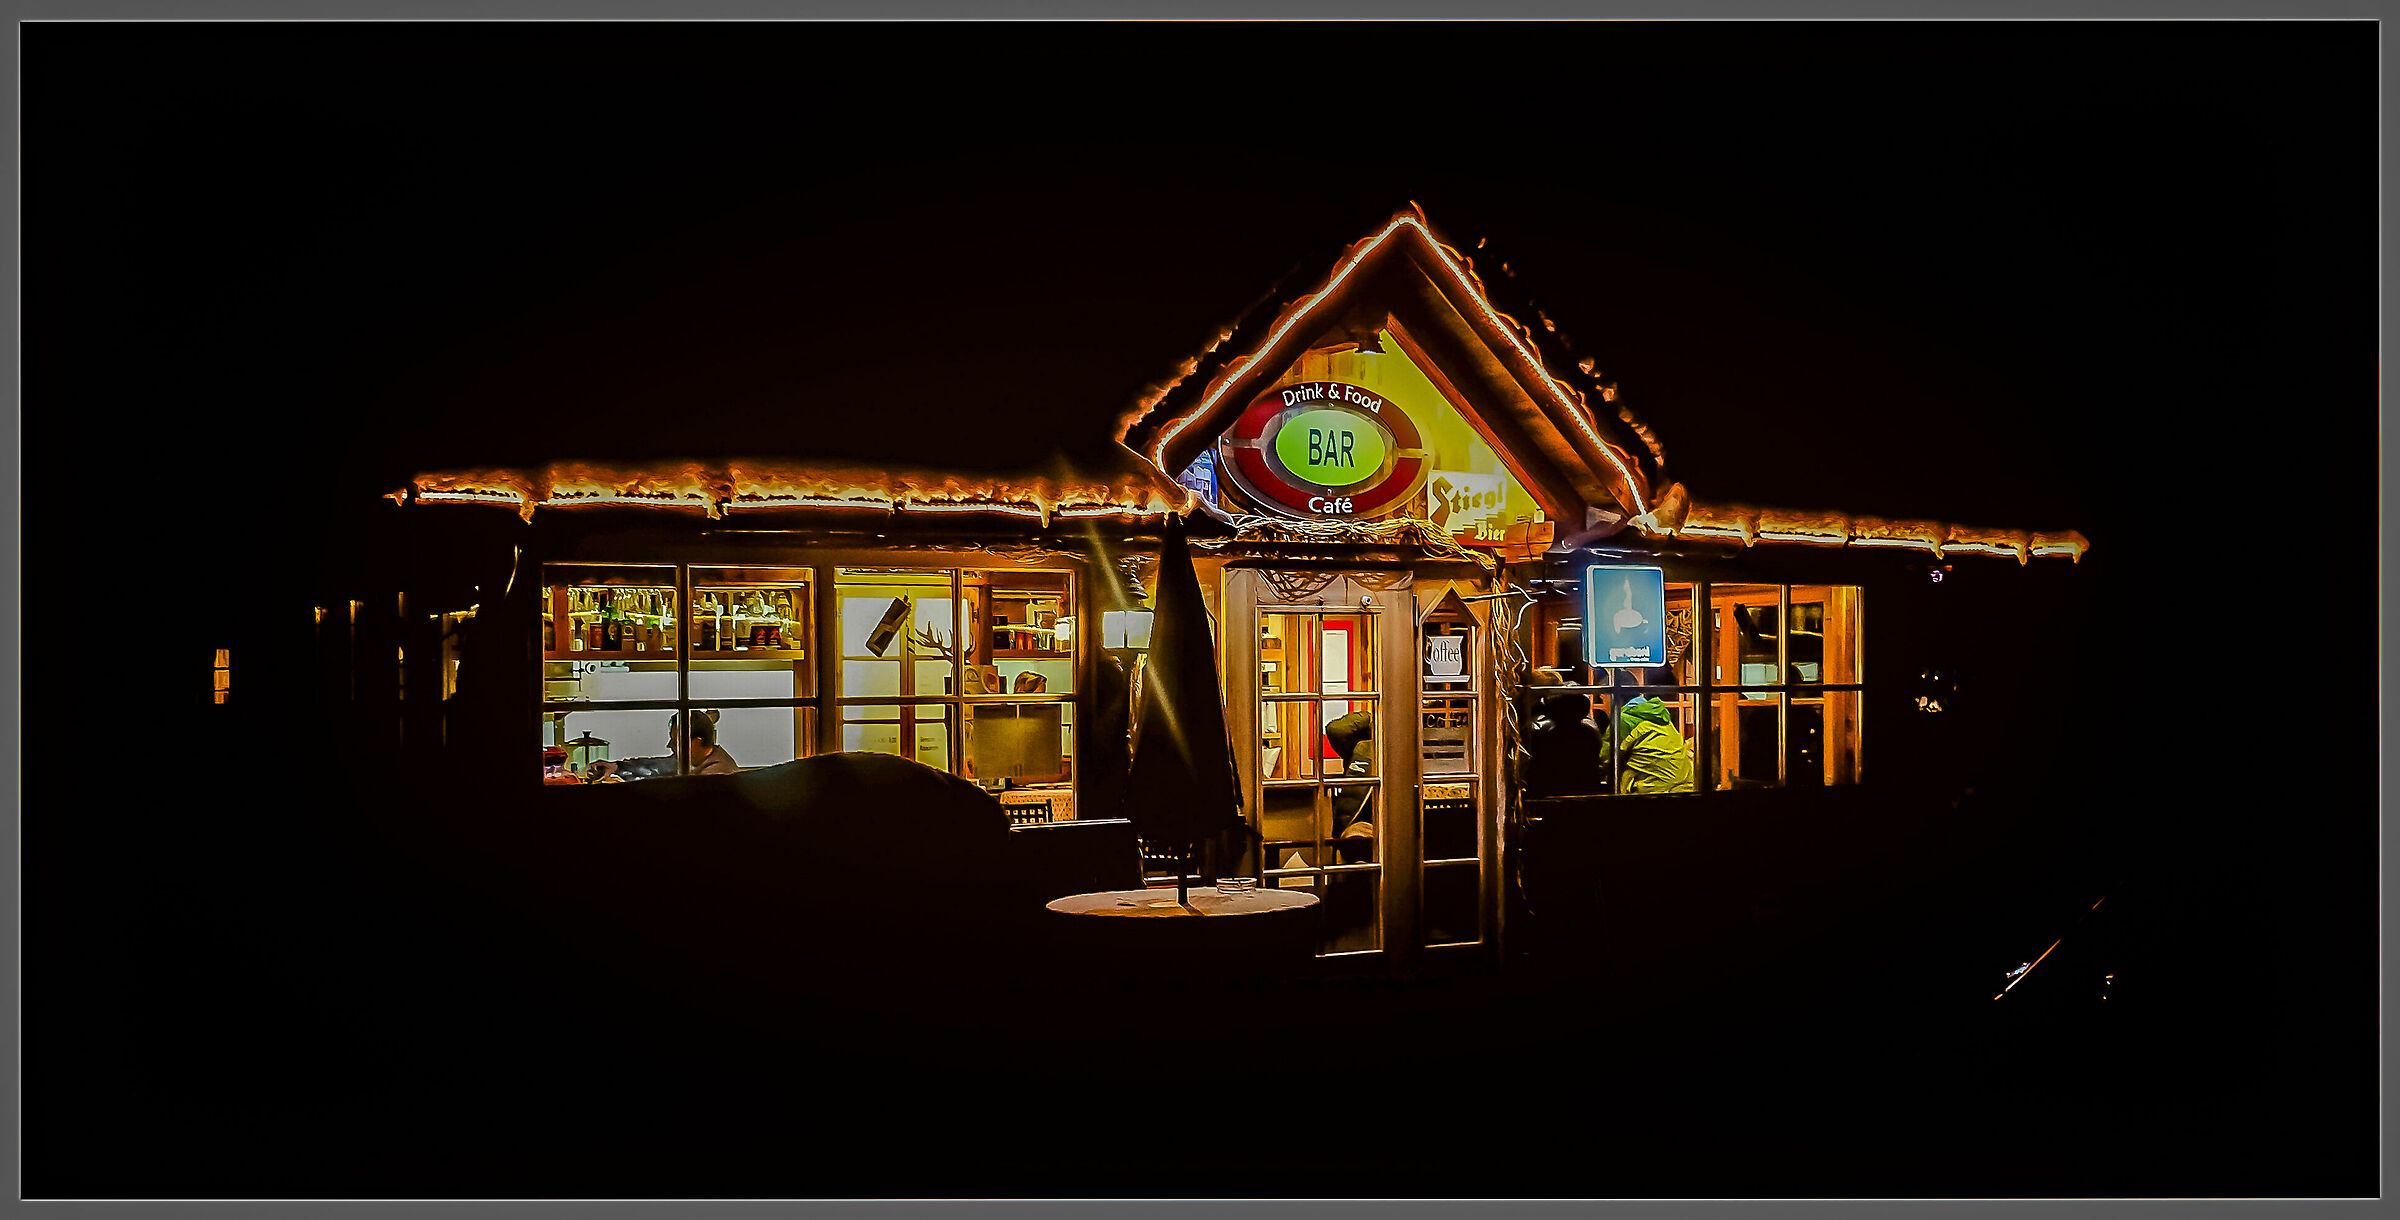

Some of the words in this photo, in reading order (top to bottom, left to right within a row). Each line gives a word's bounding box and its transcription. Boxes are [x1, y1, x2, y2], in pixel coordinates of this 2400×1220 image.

[1282, 382, 1324, 407] Drink
[1328, 383, 1341, 400] &
[1344, 385, 1382, 414] Food
[1308, 428, 1355, 468] BAR
[1308, 496, 1353, 514] Café
[1429, 475, 1503, 528] Stiegl
[1474, 520, 1506, 541] Bier
[1424, 636, 1460, 664] Coffee
